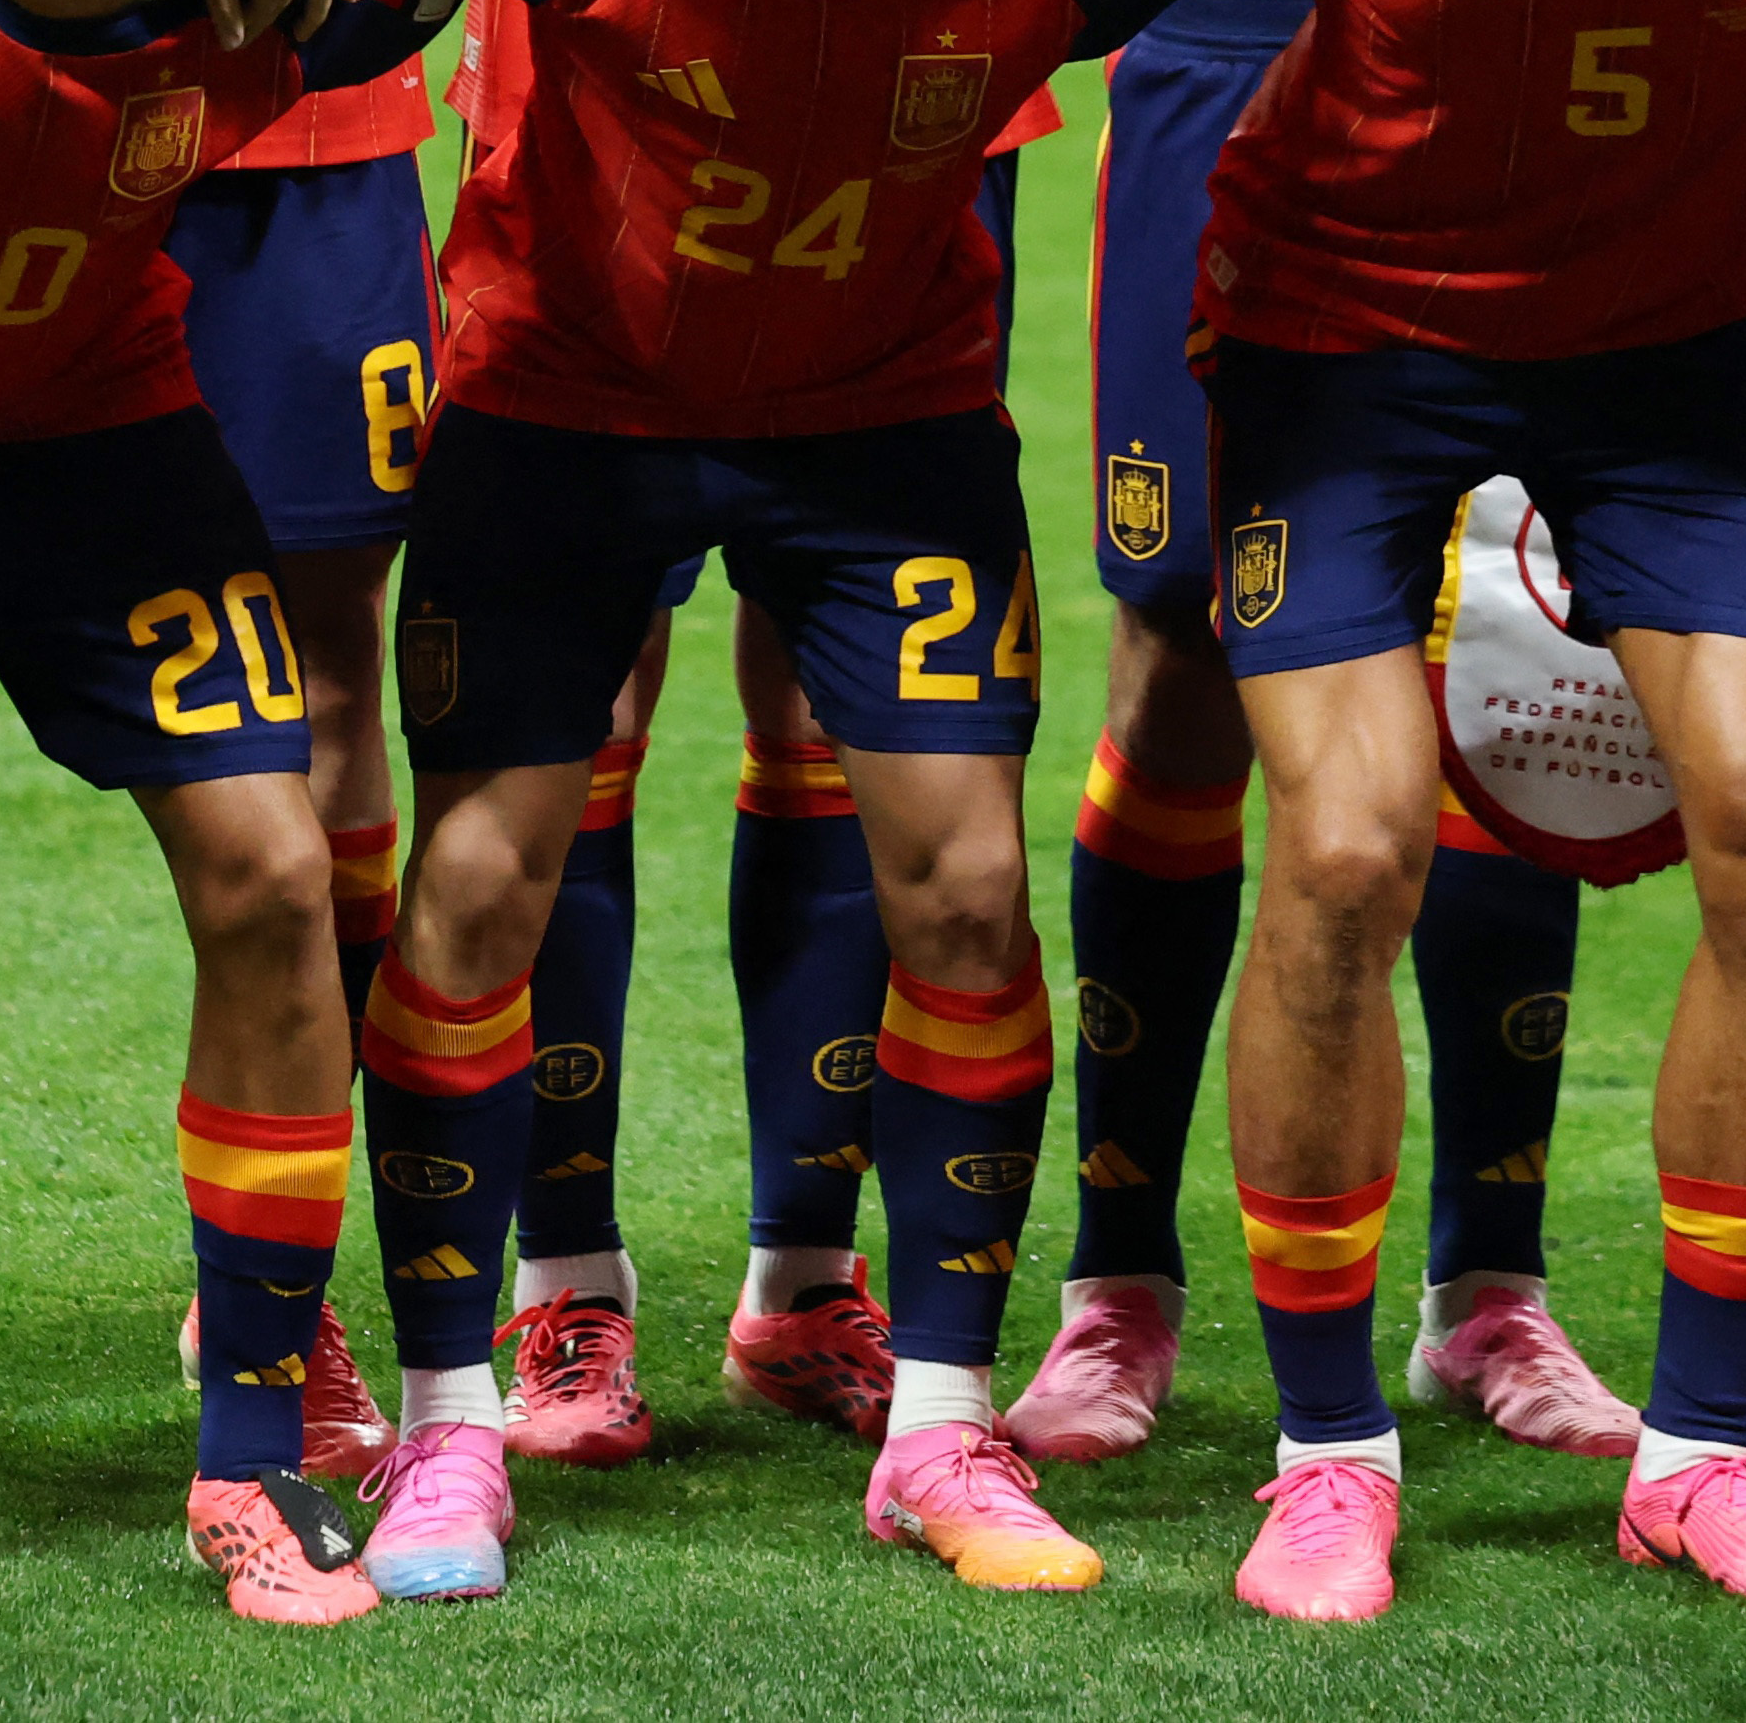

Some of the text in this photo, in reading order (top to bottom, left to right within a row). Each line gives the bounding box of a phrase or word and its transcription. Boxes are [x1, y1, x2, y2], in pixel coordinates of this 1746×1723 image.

[1565, 27, 1652, 137] 5
[673, 159, 873, 280] 24
[360, 339, 426, 493] 8
[127, 572, 305, 736] 20
[1491, 754, 1527, 771] DE
[832, 1045, 875, 1064] RF
